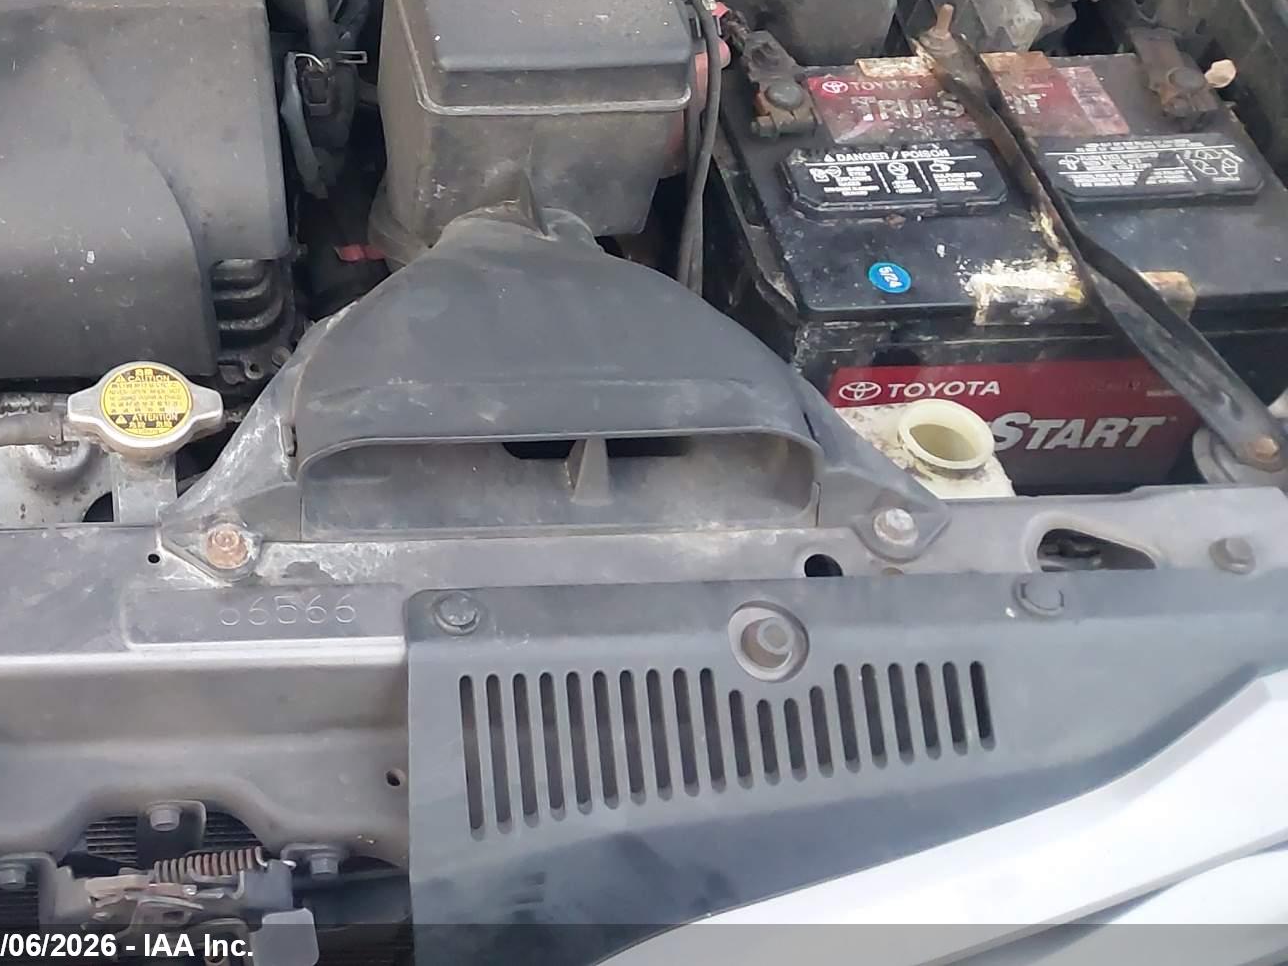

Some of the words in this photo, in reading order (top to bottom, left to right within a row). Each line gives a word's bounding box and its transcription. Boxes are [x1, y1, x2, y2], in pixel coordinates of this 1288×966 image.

[849, 80, 923, 92] TOYOTA
[836, 151, 890, 162] DANGER
[900, 149, 951, 160] POISON
[127, 374, 170, 383] CAUTION
[888, 380, 1001, 398] TOYOTA
[990, 412, 1169, 451] START
